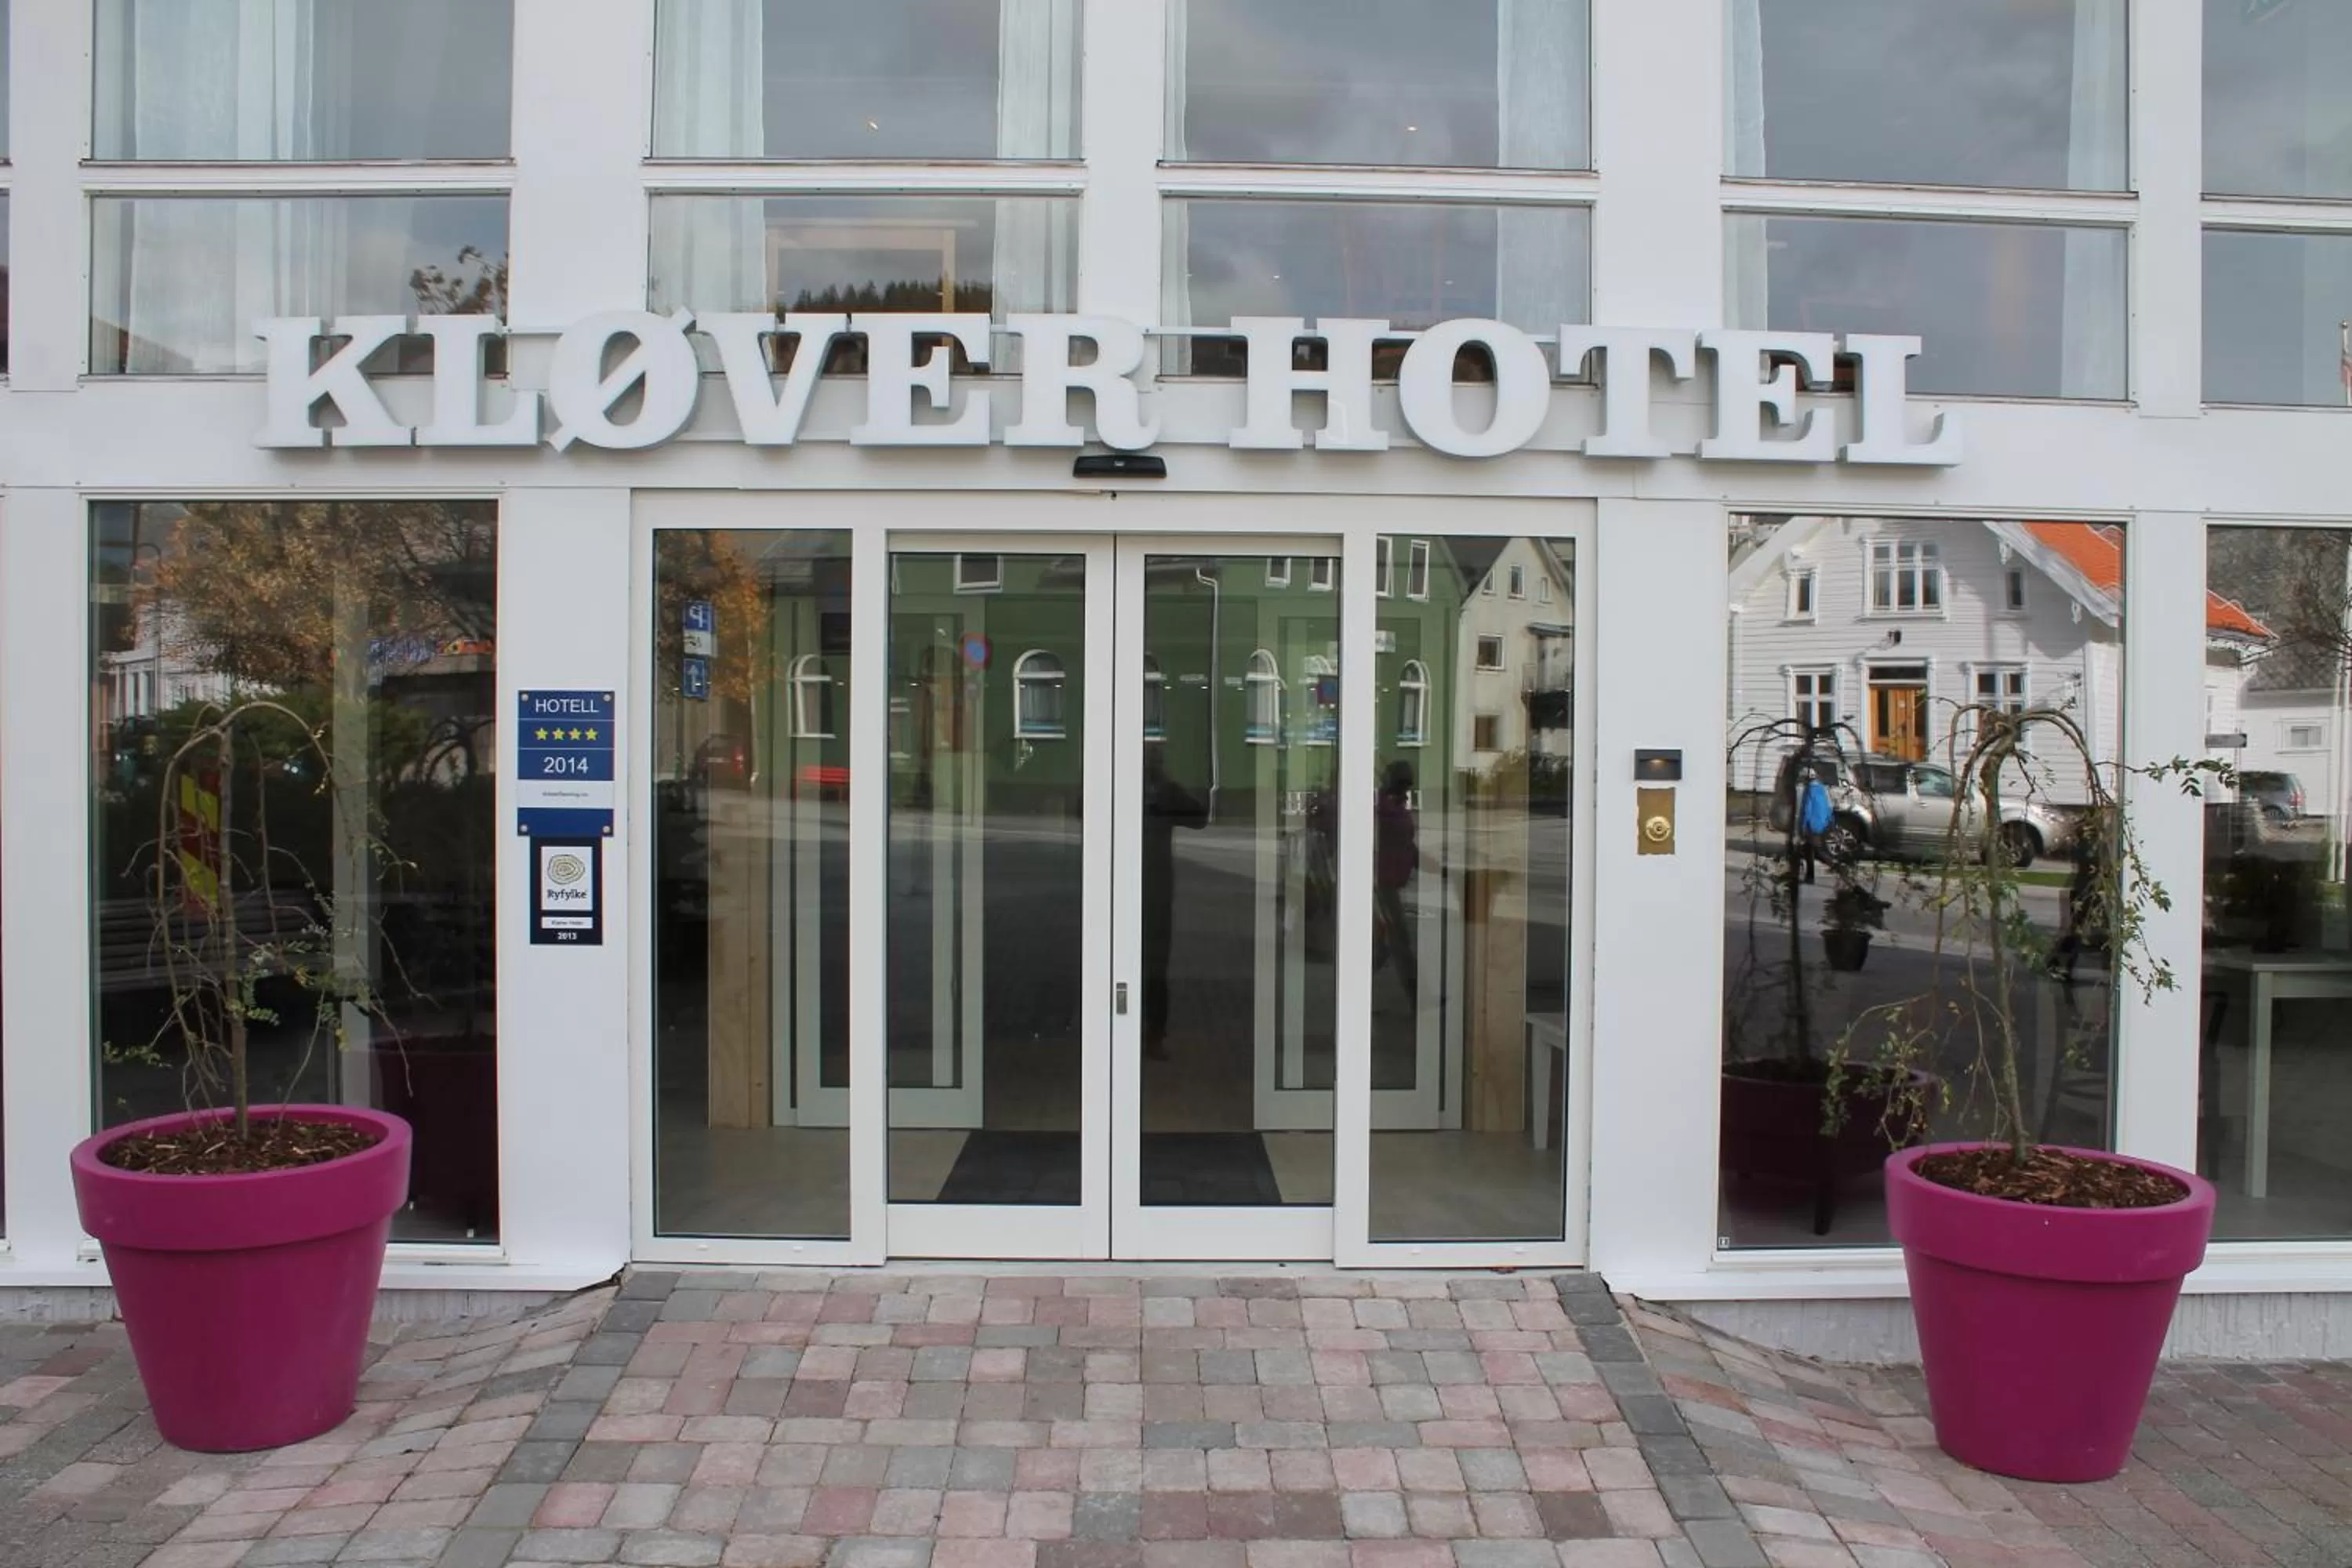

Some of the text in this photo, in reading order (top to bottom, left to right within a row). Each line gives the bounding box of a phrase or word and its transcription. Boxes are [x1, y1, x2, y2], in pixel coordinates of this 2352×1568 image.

[252, 306, 1962, 466] KLØVER HOTEL
[535, 699, 600, 713] HOTELL
[543, 756, 590, 774] 2014
[546, 888, 587, 901] Ryfylke
